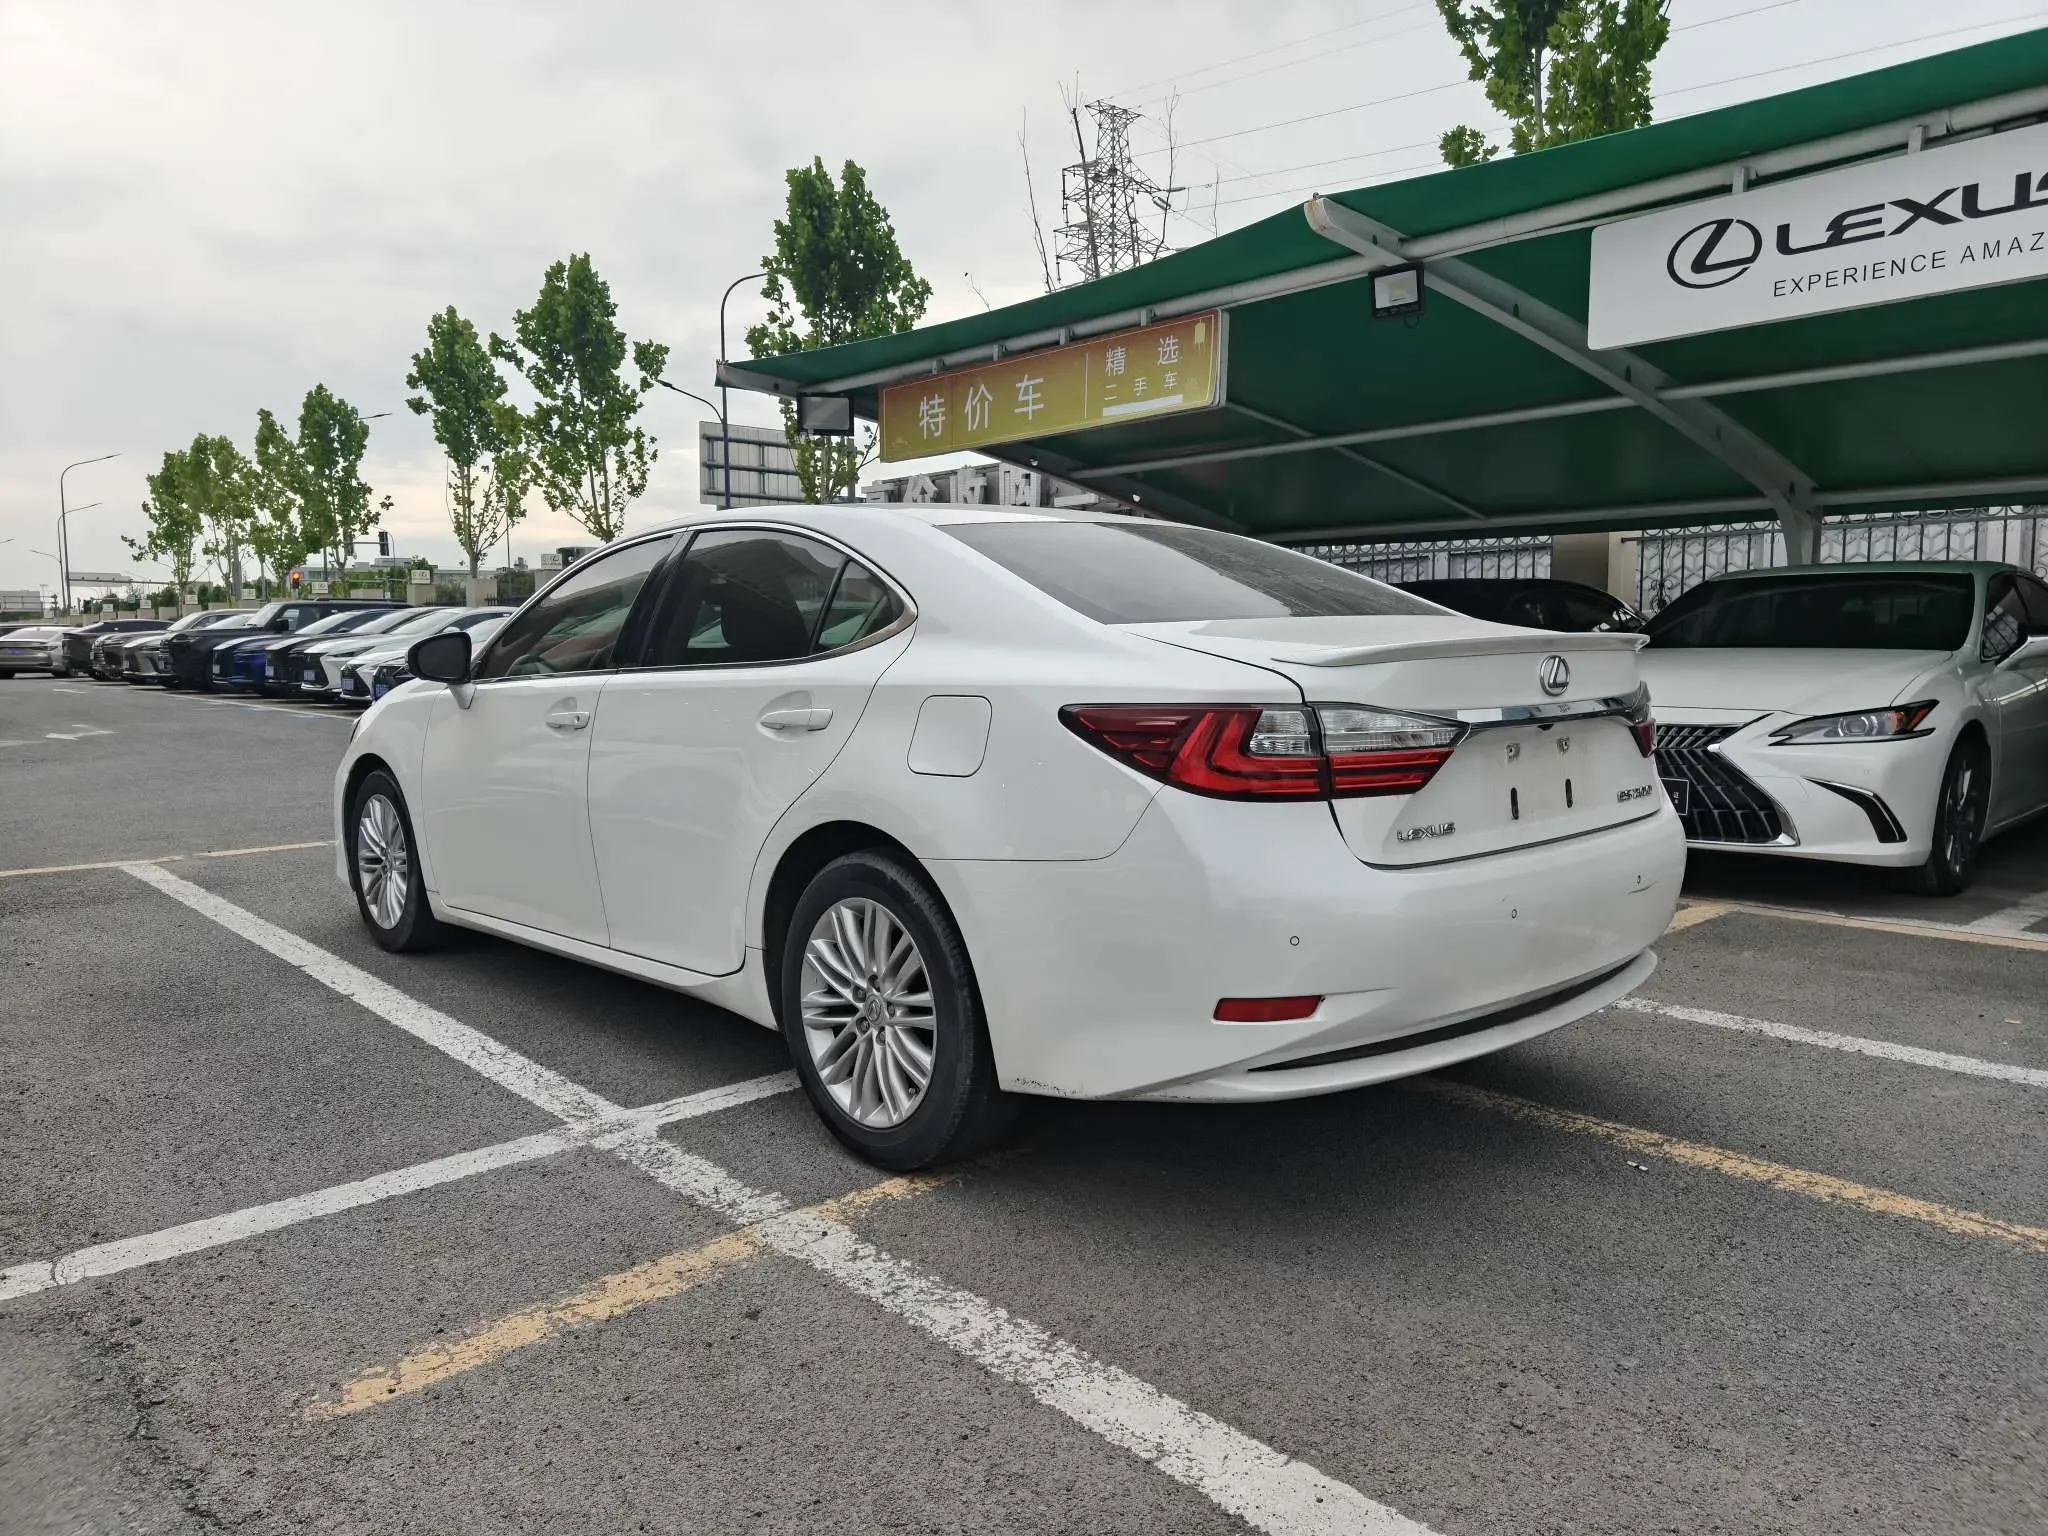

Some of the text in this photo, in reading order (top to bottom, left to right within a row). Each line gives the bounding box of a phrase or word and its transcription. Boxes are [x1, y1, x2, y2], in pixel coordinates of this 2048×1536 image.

[1776, 171, 2048, 256] LEXU
[1773, 231, 2045, 298] EXPERIENCE AMAZ
[1105, 335, 1180, 377] 精选
[919, 373, 1045, 440] 特价车
[1104, 370, 1178, 401] 二手车
[1396, 822, 1456, 842] LEXUS
